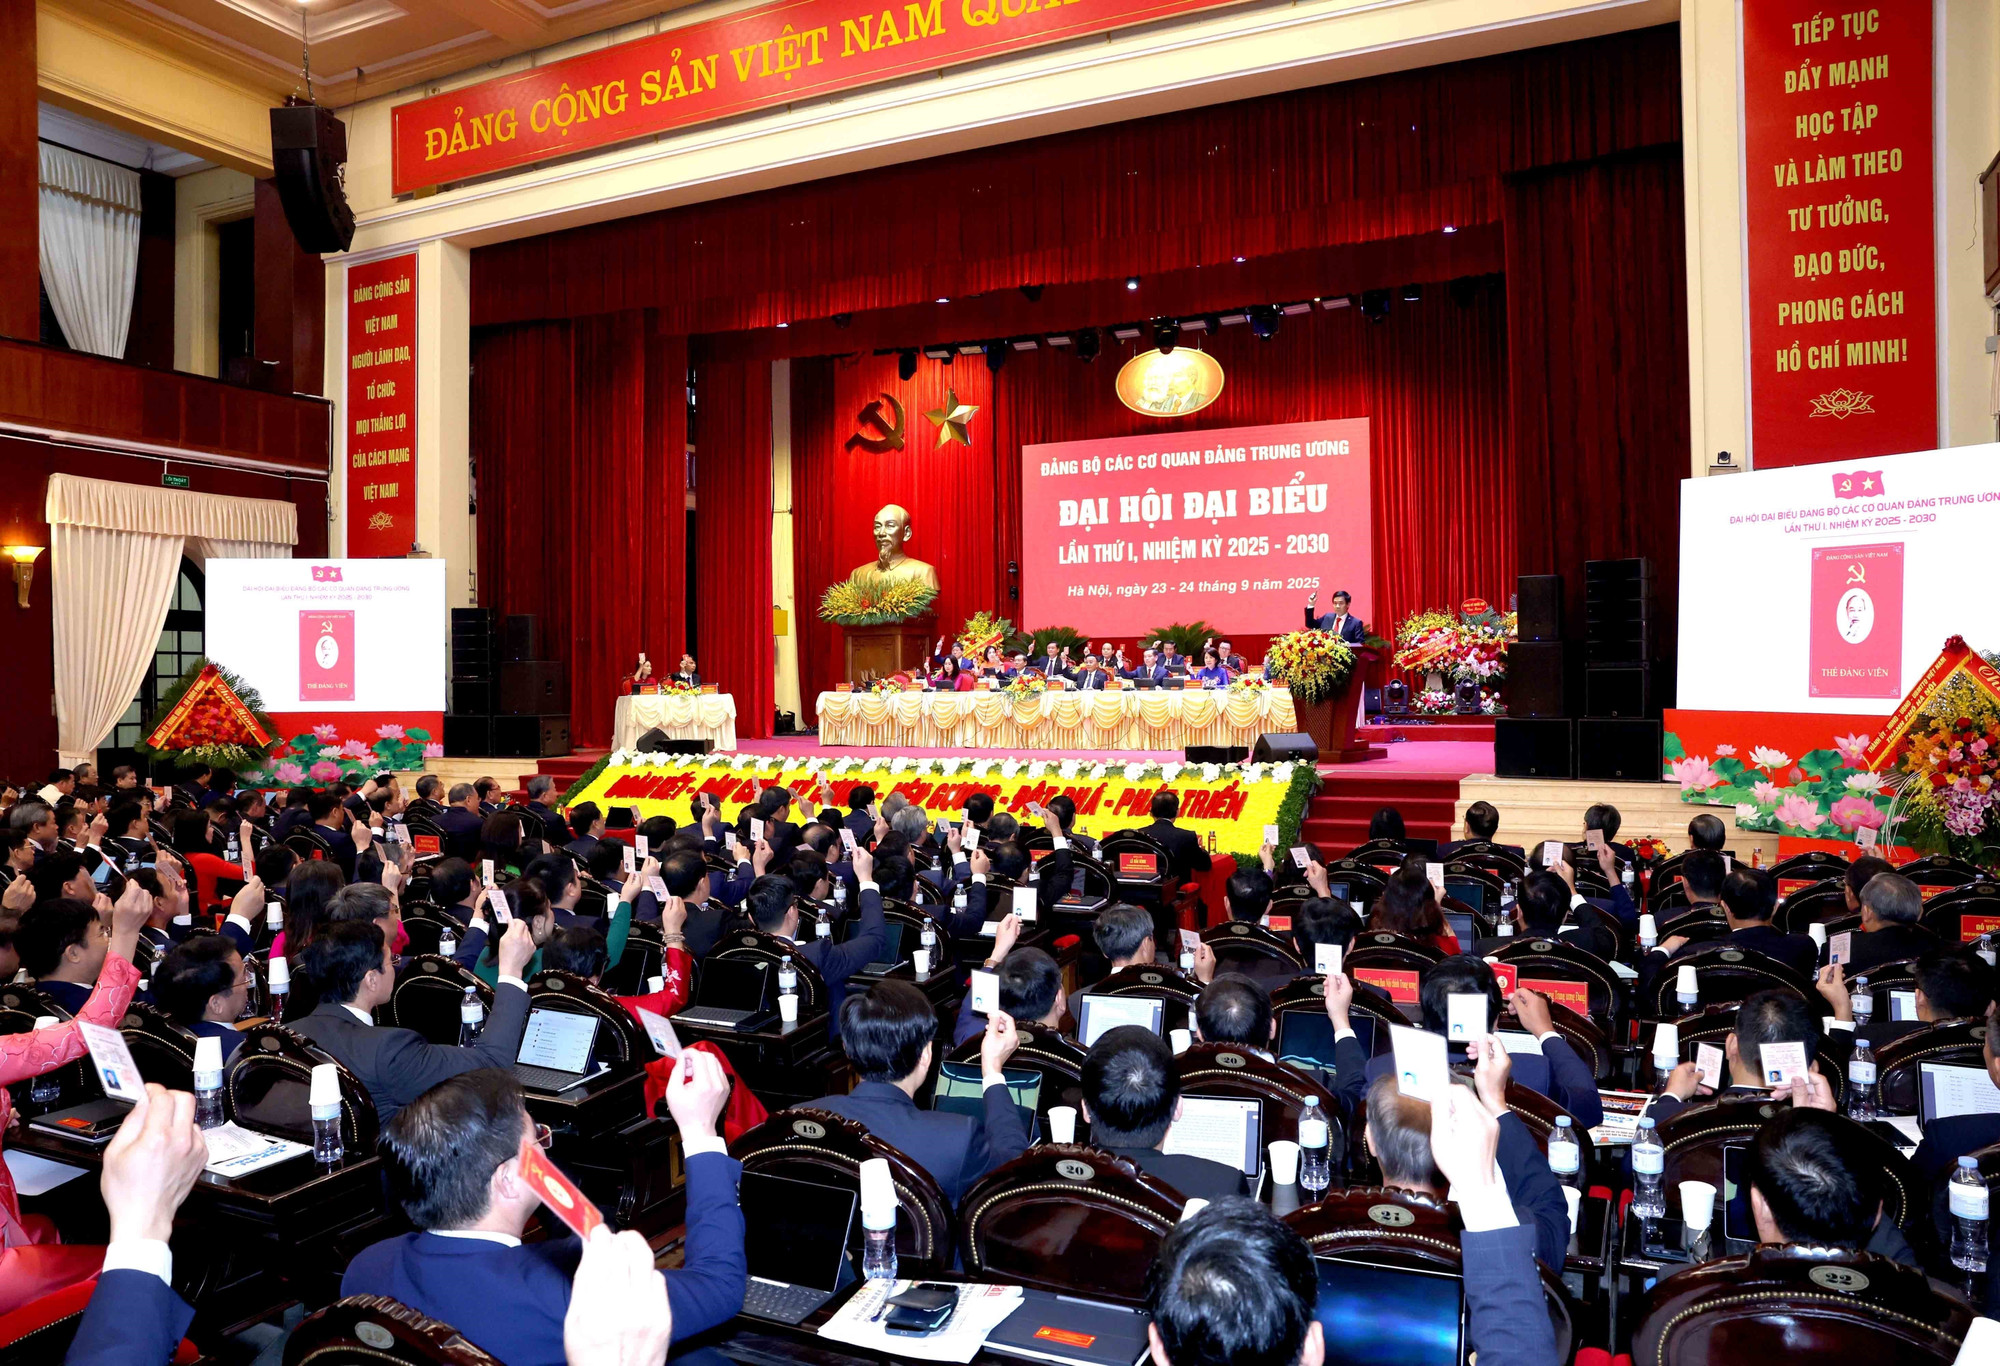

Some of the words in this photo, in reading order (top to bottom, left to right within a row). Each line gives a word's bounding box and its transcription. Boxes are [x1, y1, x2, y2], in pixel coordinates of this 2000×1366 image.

[1792, 12, 1834, 46] TIẾP
[1842, 8, 1880, 40] TỤC
[425, 106, 518, 161] ĐẢNG
[529, 79, 626, 138] CỘNG
[640, 50, 720, 108] SẢN
[729, 24, 829, 86] VIỆT
[840, 2, 946, 58] NAM
[1784, 58, 1822, 94] ĐẨY
[1830, 54, 1889, 88] MẠNH
[1796, 112, 1834, 142] HỌC
[1840, 102, 1878, 135] TẬP
[1774, 158, 1798, 188] VÀ
[1804, 154, 1846, 184] LÀM
[1852, 148, 1902, 177] THEO
[1788, 205, 1813, 232] TƯ
[1818, 194, 1890, 228] TƯỞNG,
[1794, 252, 1832, 282] ĐẠO
[1838, 243, 1886, 274] ĐỨC,
[354, 283, 372, 304] ĐẢNG
[374, 280, 394, 302] CỘNG
[394, 275, 410, 294] SẢN
[1778, 298, 1844, 326] PHONG
[1850, 288, 1904, 318] CÁCH
[364, 316, 380, 336] VIỆT
[381, 314, 398, 330] NAM
[352, 350, 374, 370] NGƯỜI
[374, 348, 393, 366] LÃNH
[394, 345, 410, 364] ĐẠO,
[1776, 340, 1801, 372] HỒ
[1807, 340, 1840, 370] CHÍ
[1846, 338, 1908, 366] MINH!
[366, 378, 376, 400] TỔ
[377, 382, 396, 398] CHỨC
[356, 418, 370, 436] MỌI
[370, 412, 394, 432] THẮNG
[394, 412, 406, 430] LỢI
[352, 450, 366, 468] CỦA
[368, 449, 387, 467] CÁCH
[388, 448, 410, 466] MẠNG
[1040, 458, 1078, 476] ĐẢNG
[1082, 456, 1101, 476] BỘ
[1105, 453, 1134, 472] CÁC
[1138, 453, 1158, 470] CƠ
[1160, 450, 1200, 470] QUAN
[1204, 444, 1246, 464] ĐẢNG
[1250, 443, 1302, 461] TRUNG
[1306, 440, 1350, 457] ƯƠNG
[364, 482, 378, 502] VIỆT
[380, 482, 398, 499] NAM!
[1058, 498, 1110, 532] ĐẠI
[1119, 487, 1173, 529] HỘI
[1183, 489, 1238, 526] ĐẠI
[1249, 470, 1328, 516] BIỂU
[1877, 501, 1904, 512] QUAN
[1938, 494, 1974, 506] TRUNG
[1875, 516, 1901, 526] 2025
[1909, 513, 1936, 524] 2030
[1058, 538, 1090, 565] LẦN
[1094, 540, 1124, 563] THỨ
[1128, 542, 1138, 564] I,
[1142, 536, 1196, 564] NHIỆM
[1202, 534, 1223, 558] KỲ
[1228, 536, 1270, 557] 2025
[1286, 533, 1330, 554] 2030
[1067, 584, 1084, 596] Hà
[1087, 583, 1112, 598] Nội,
[1116, 584, 1148, 598] ngày
[1151, 582, 1166, 594] 23
[1178, 581, 1195, 593] 24
[1198, 578, 1237, 594] tháng
[1240, 579, 1250, 591] 9
[1253, 578, 1282, 590] năm
[1286, 577, 1320, 590] 2025
[1223, 1056, 1238, 1064] 20
[802, 1124, 817, 1134] 19
[1066, 1164, 1084, 1176] 20
[1825, 1272, 1852, 1284] 22
